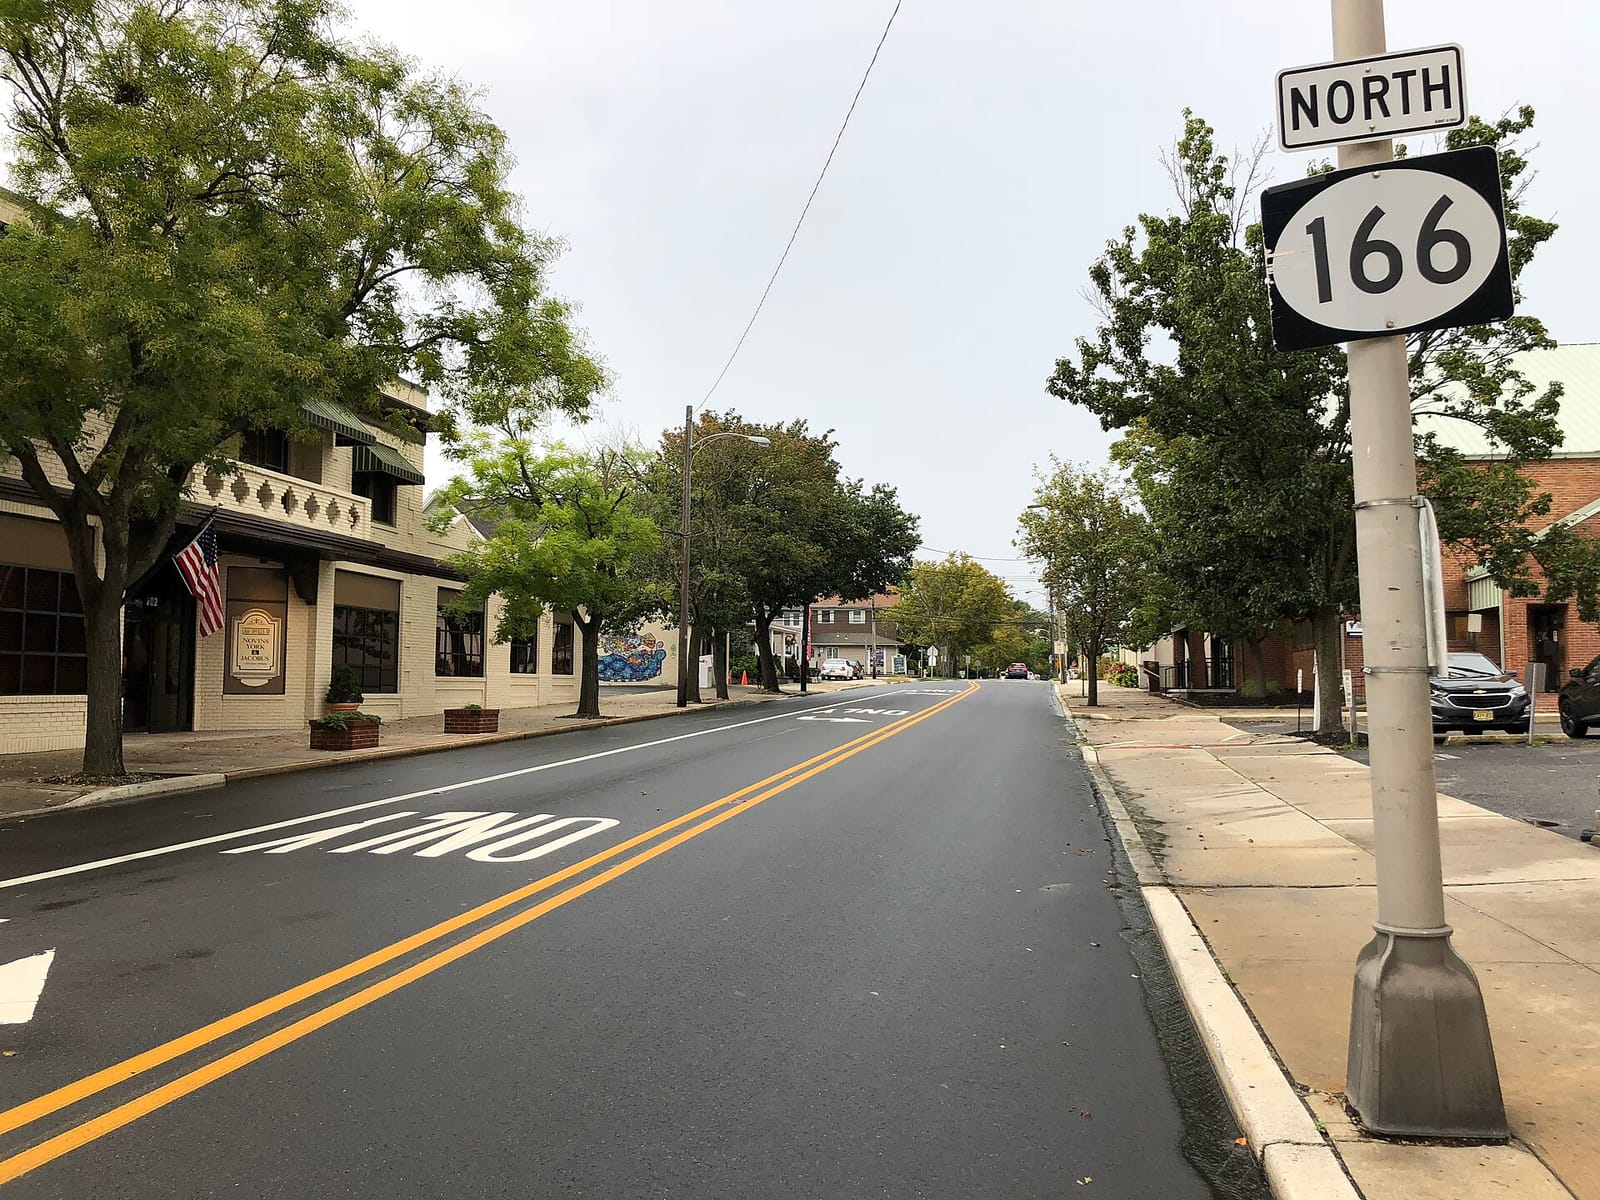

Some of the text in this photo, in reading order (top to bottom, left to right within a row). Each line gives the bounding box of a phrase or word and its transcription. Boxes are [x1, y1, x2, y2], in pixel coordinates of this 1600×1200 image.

[1290, 64, 1453, 131] NORTH
[1305, 193, 1472, 304] 166
[812, 708, 909, 716] ONLY
[218, 811, 621, 863] ONLY
